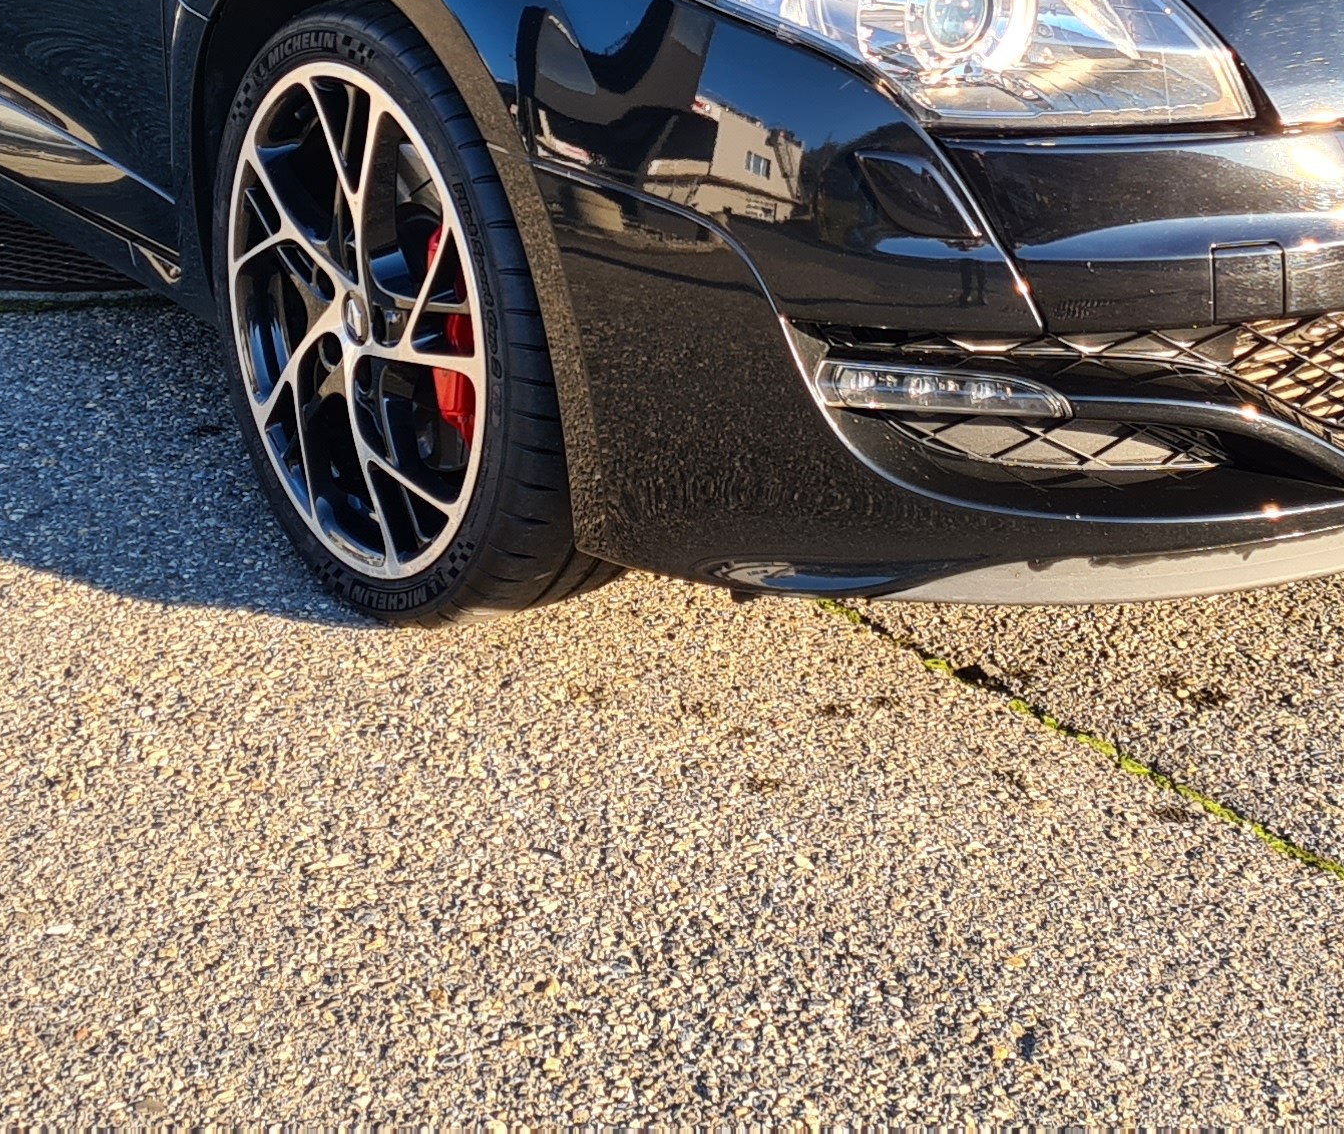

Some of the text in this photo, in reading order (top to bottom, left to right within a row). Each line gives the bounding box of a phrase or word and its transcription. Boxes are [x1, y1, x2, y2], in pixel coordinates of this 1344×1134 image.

[268, 31, 336, 69] MICHELIN
[470, 234, 495, 309] Sport
[487, 308, 499, 355] Cup
[350, 585, 427, 611] MICHELIN
